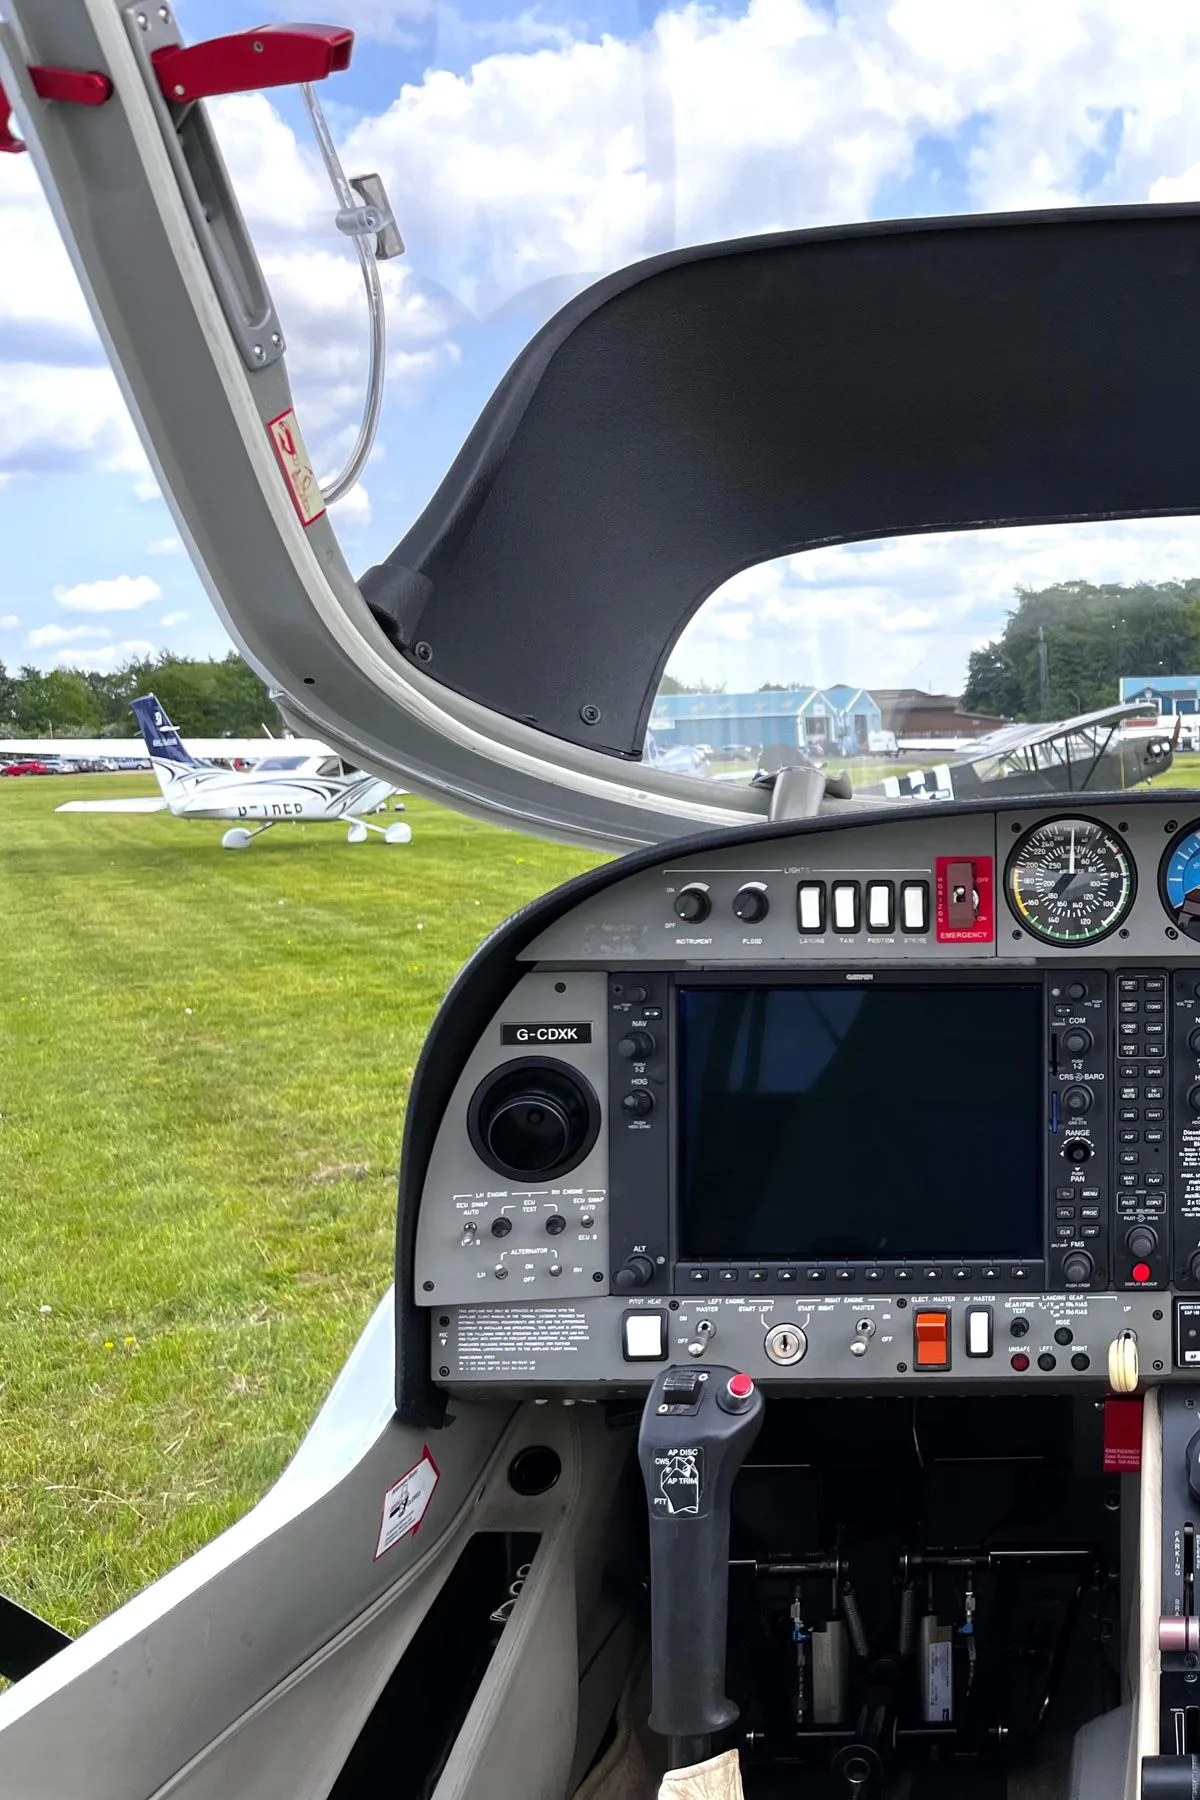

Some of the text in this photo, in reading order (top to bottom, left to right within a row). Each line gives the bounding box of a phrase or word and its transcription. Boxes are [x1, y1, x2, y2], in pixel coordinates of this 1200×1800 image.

[940, 931, 988, 939] EMERGENCY
[516, 1027, 578, 1041] G-CDXK
[1084, 1073, 1104, 1081] BARO
[1070, 1175, 1085, 1183] PAN
[633, 1245, 646, 1253] ALT
